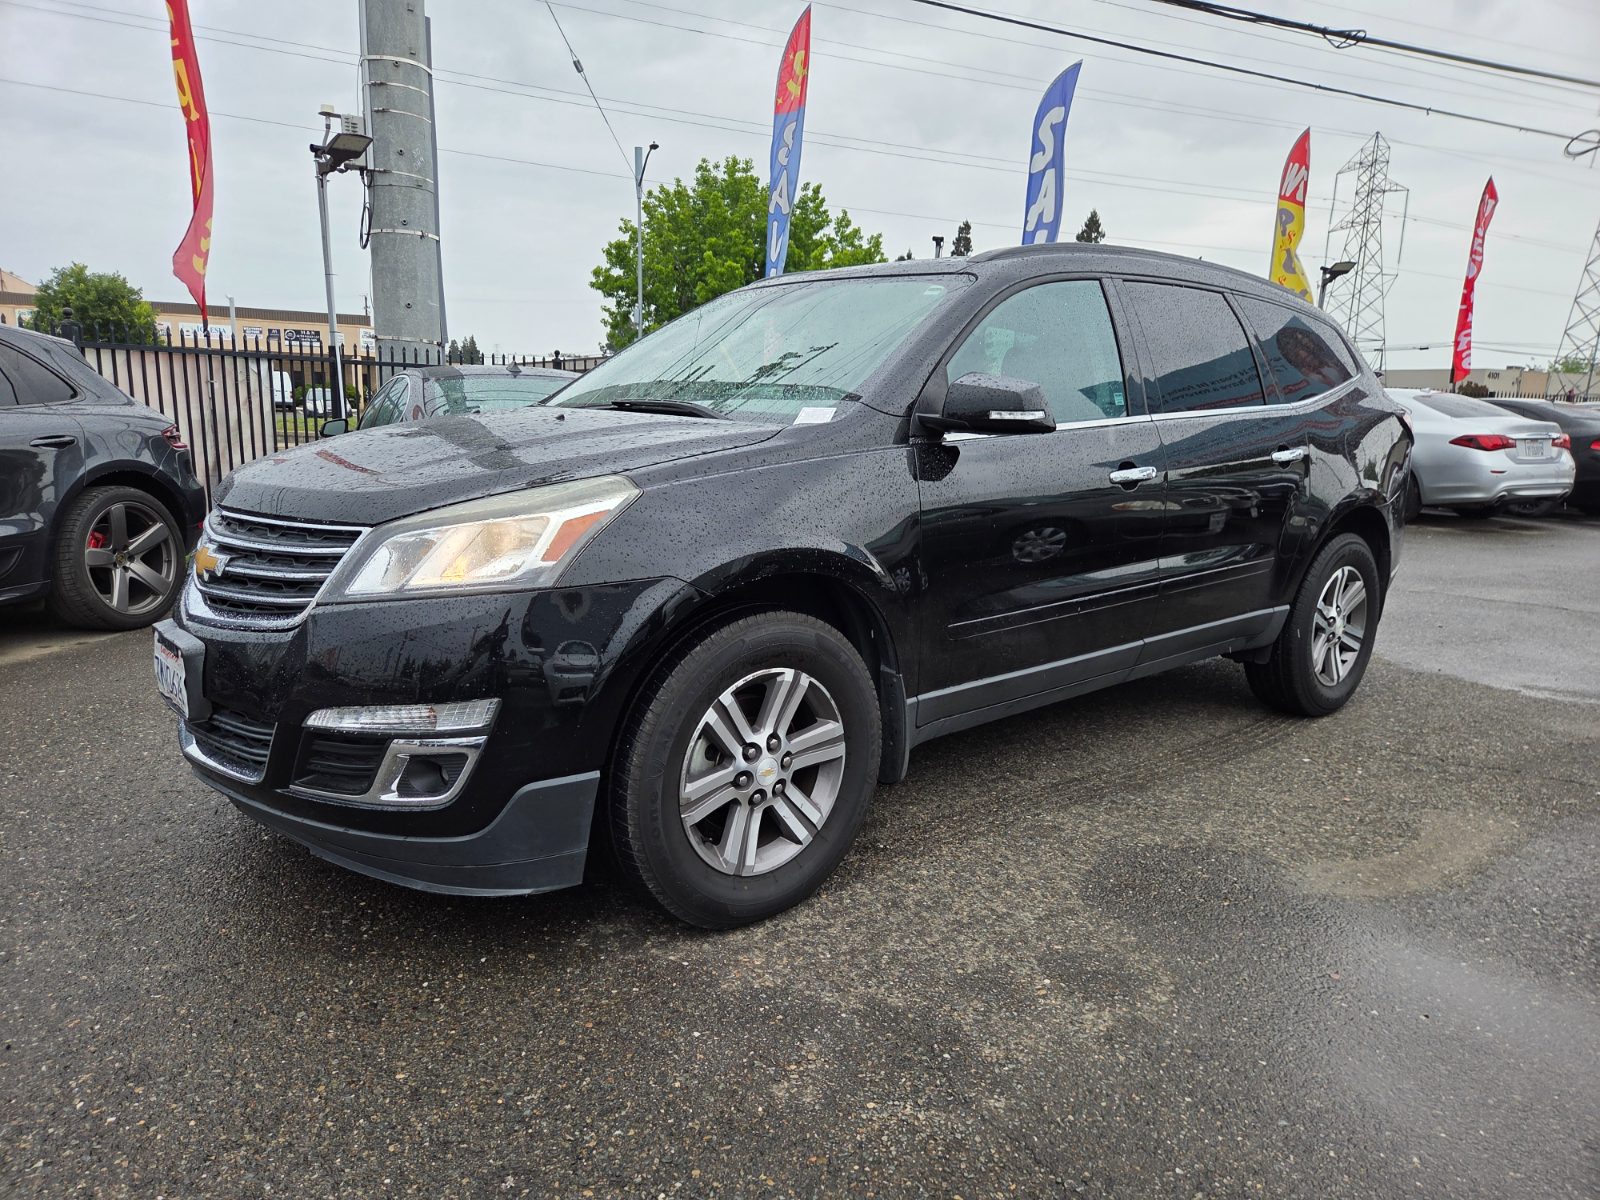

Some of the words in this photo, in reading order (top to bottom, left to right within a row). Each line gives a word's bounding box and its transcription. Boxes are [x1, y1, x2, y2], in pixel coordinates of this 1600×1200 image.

[1025, 106, 1066, 244] SA
[196, 324, 227, 335] IGESIA
[1487, 370, 1500, 380] 4101
